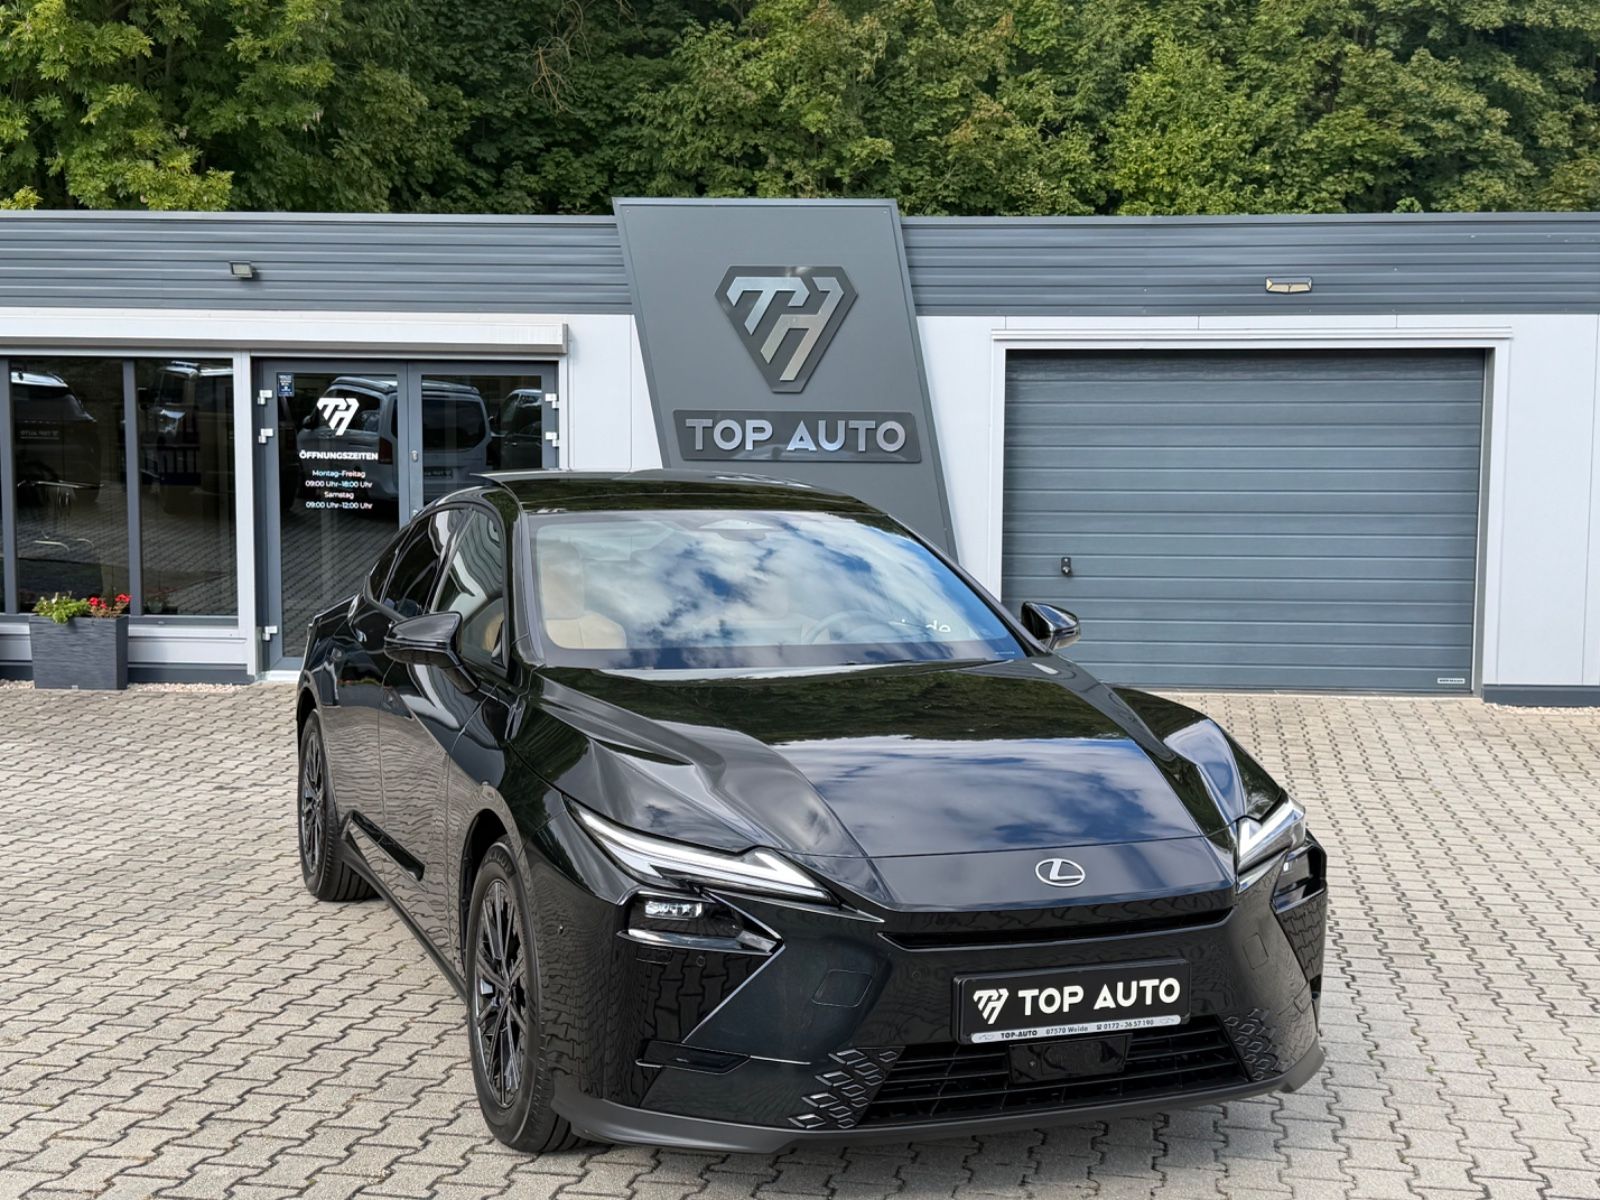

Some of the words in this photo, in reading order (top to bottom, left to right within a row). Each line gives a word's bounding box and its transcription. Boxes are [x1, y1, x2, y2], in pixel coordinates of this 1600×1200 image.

[685, 418, 773, 451] TOP
[786, 419, 907, 452] AUTO
[299, 449, 379, 460] ÖFFNUNGSZEITEN
[305, 480, 325, 488] 09:00
[360, 481, 373, 489] Uhr
[324, 490, 355, 500] Samstag
[305, 501, 325, 509] 09:00
[360, 502, 373, 510] Uhr
[1018, 985, 1084, 1016] TOP
[1093, 977, 1181, 1010] AUTO
[1001, 1029, 1038, 1039] TOP-AUTO
